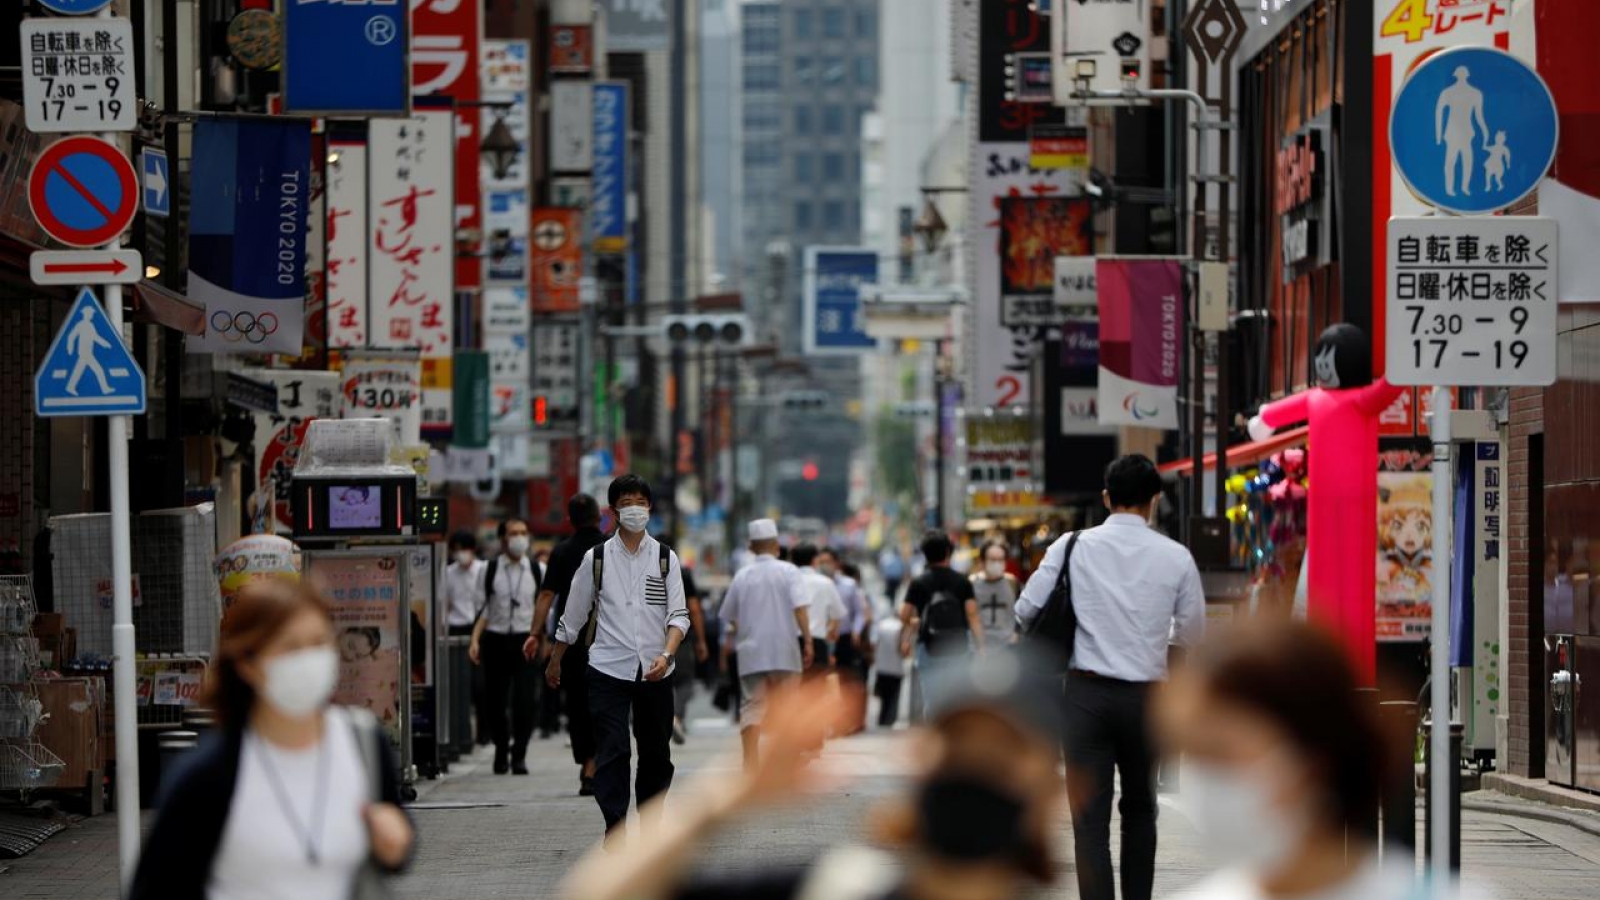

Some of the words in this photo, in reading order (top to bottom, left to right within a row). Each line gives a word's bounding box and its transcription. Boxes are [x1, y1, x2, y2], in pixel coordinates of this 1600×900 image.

[1435, 3, 1505, 34] レート
[30, 30, 123, 53] 自転車を除く
[281, 171, 297, 234] TOKYO
[278, 237, 296, 285] 2020
[1397, 234, 1549, 264] 自転車を除く
[1161, 294, 1176, 340] TOKYO
[1161, 341, 1176, 378] 2020
[1484, 466, 1499, 561] 証明写真
